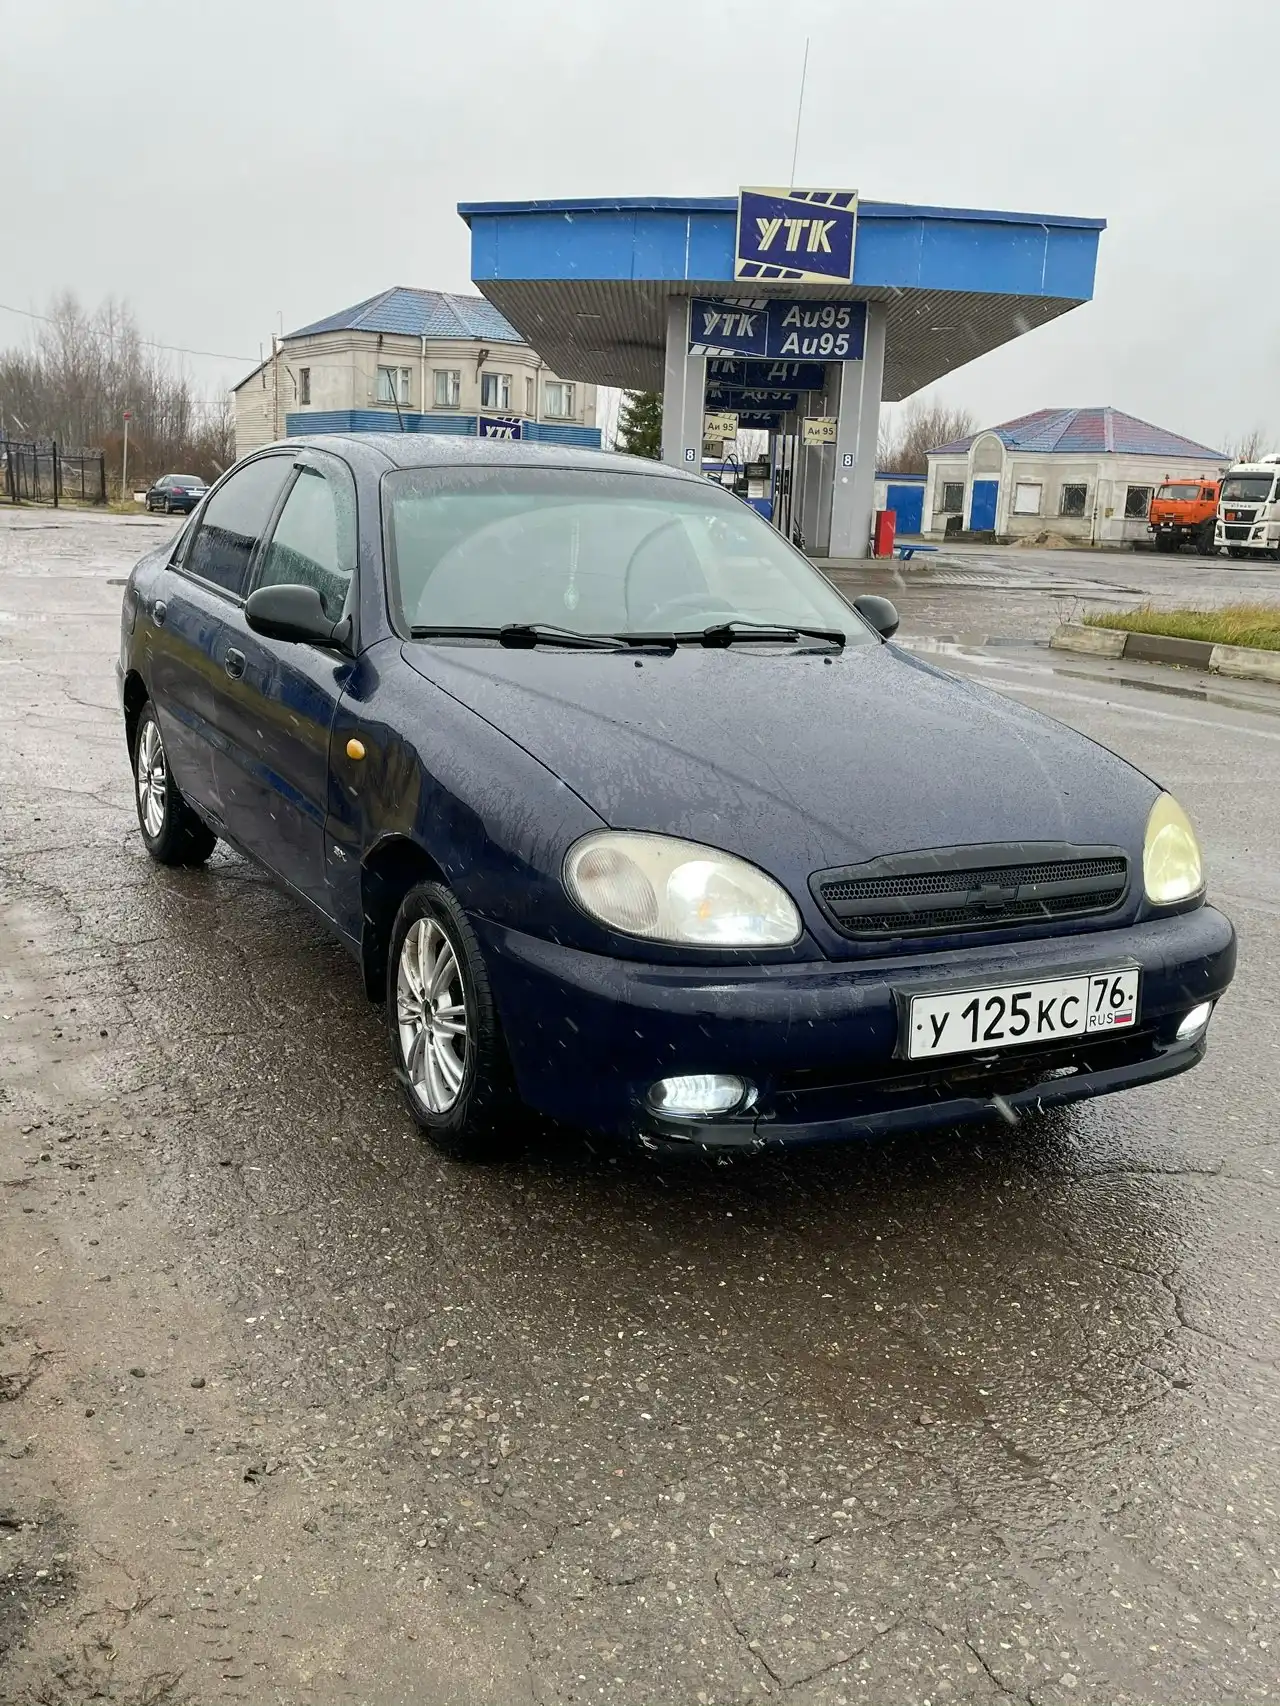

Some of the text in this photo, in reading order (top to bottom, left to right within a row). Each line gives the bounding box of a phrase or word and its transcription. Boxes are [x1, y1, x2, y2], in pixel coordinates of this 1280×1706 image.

[756, 217, 837, 253] УТК
[702, 312, 758, 337] УТК
[710, 360, 739, 373] ТК
[723, 423, 734, 431] 95
[822, 427, 834, 435] 95
[686, 450, 694, 460] 8
[844, 455, 852, 465] 8
[1093, 976, 1125, 1012] 76
[1089, 1012, 1113, 1027] RUS
